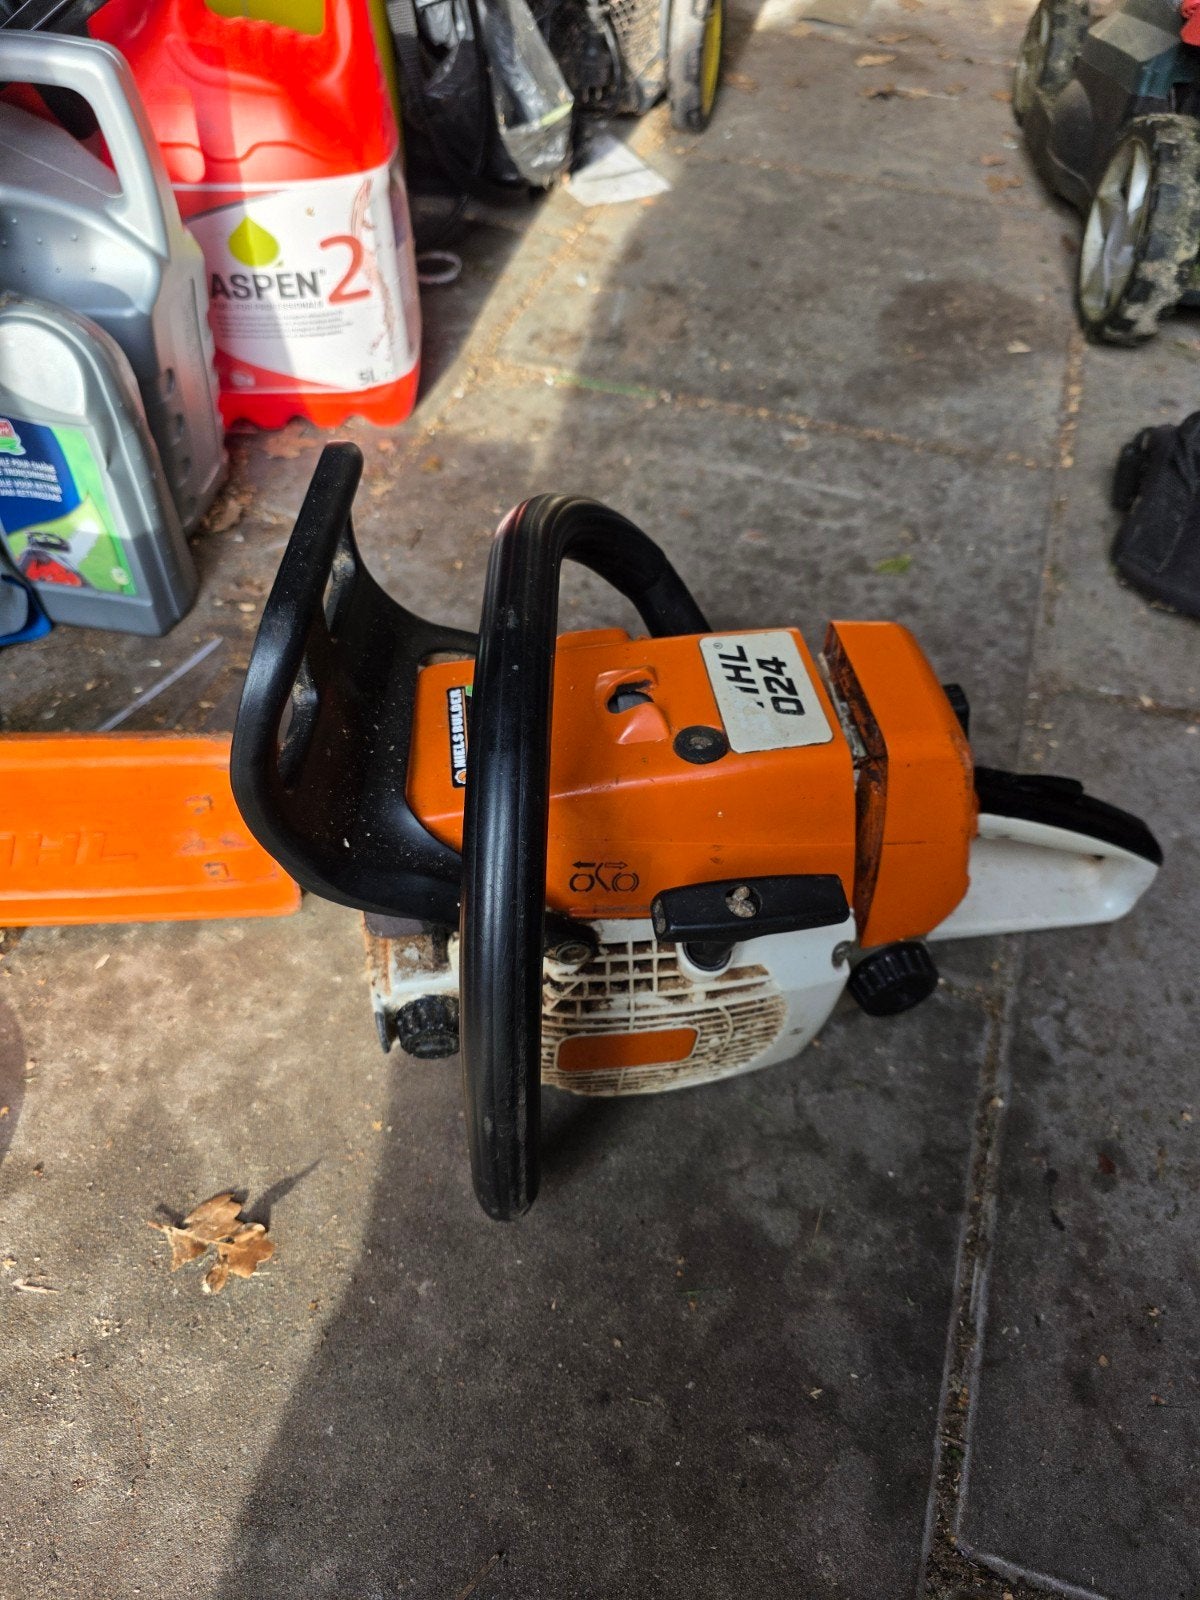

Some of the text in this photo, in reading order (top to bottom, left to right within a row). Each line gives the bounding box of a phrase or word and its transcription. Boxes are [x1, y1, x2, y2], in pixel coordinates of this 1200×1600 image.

[210, 235, 370, 302] ASPEN 2
[718, 645, 764, 708] IHL
[756, 656, 806, 716] 024
